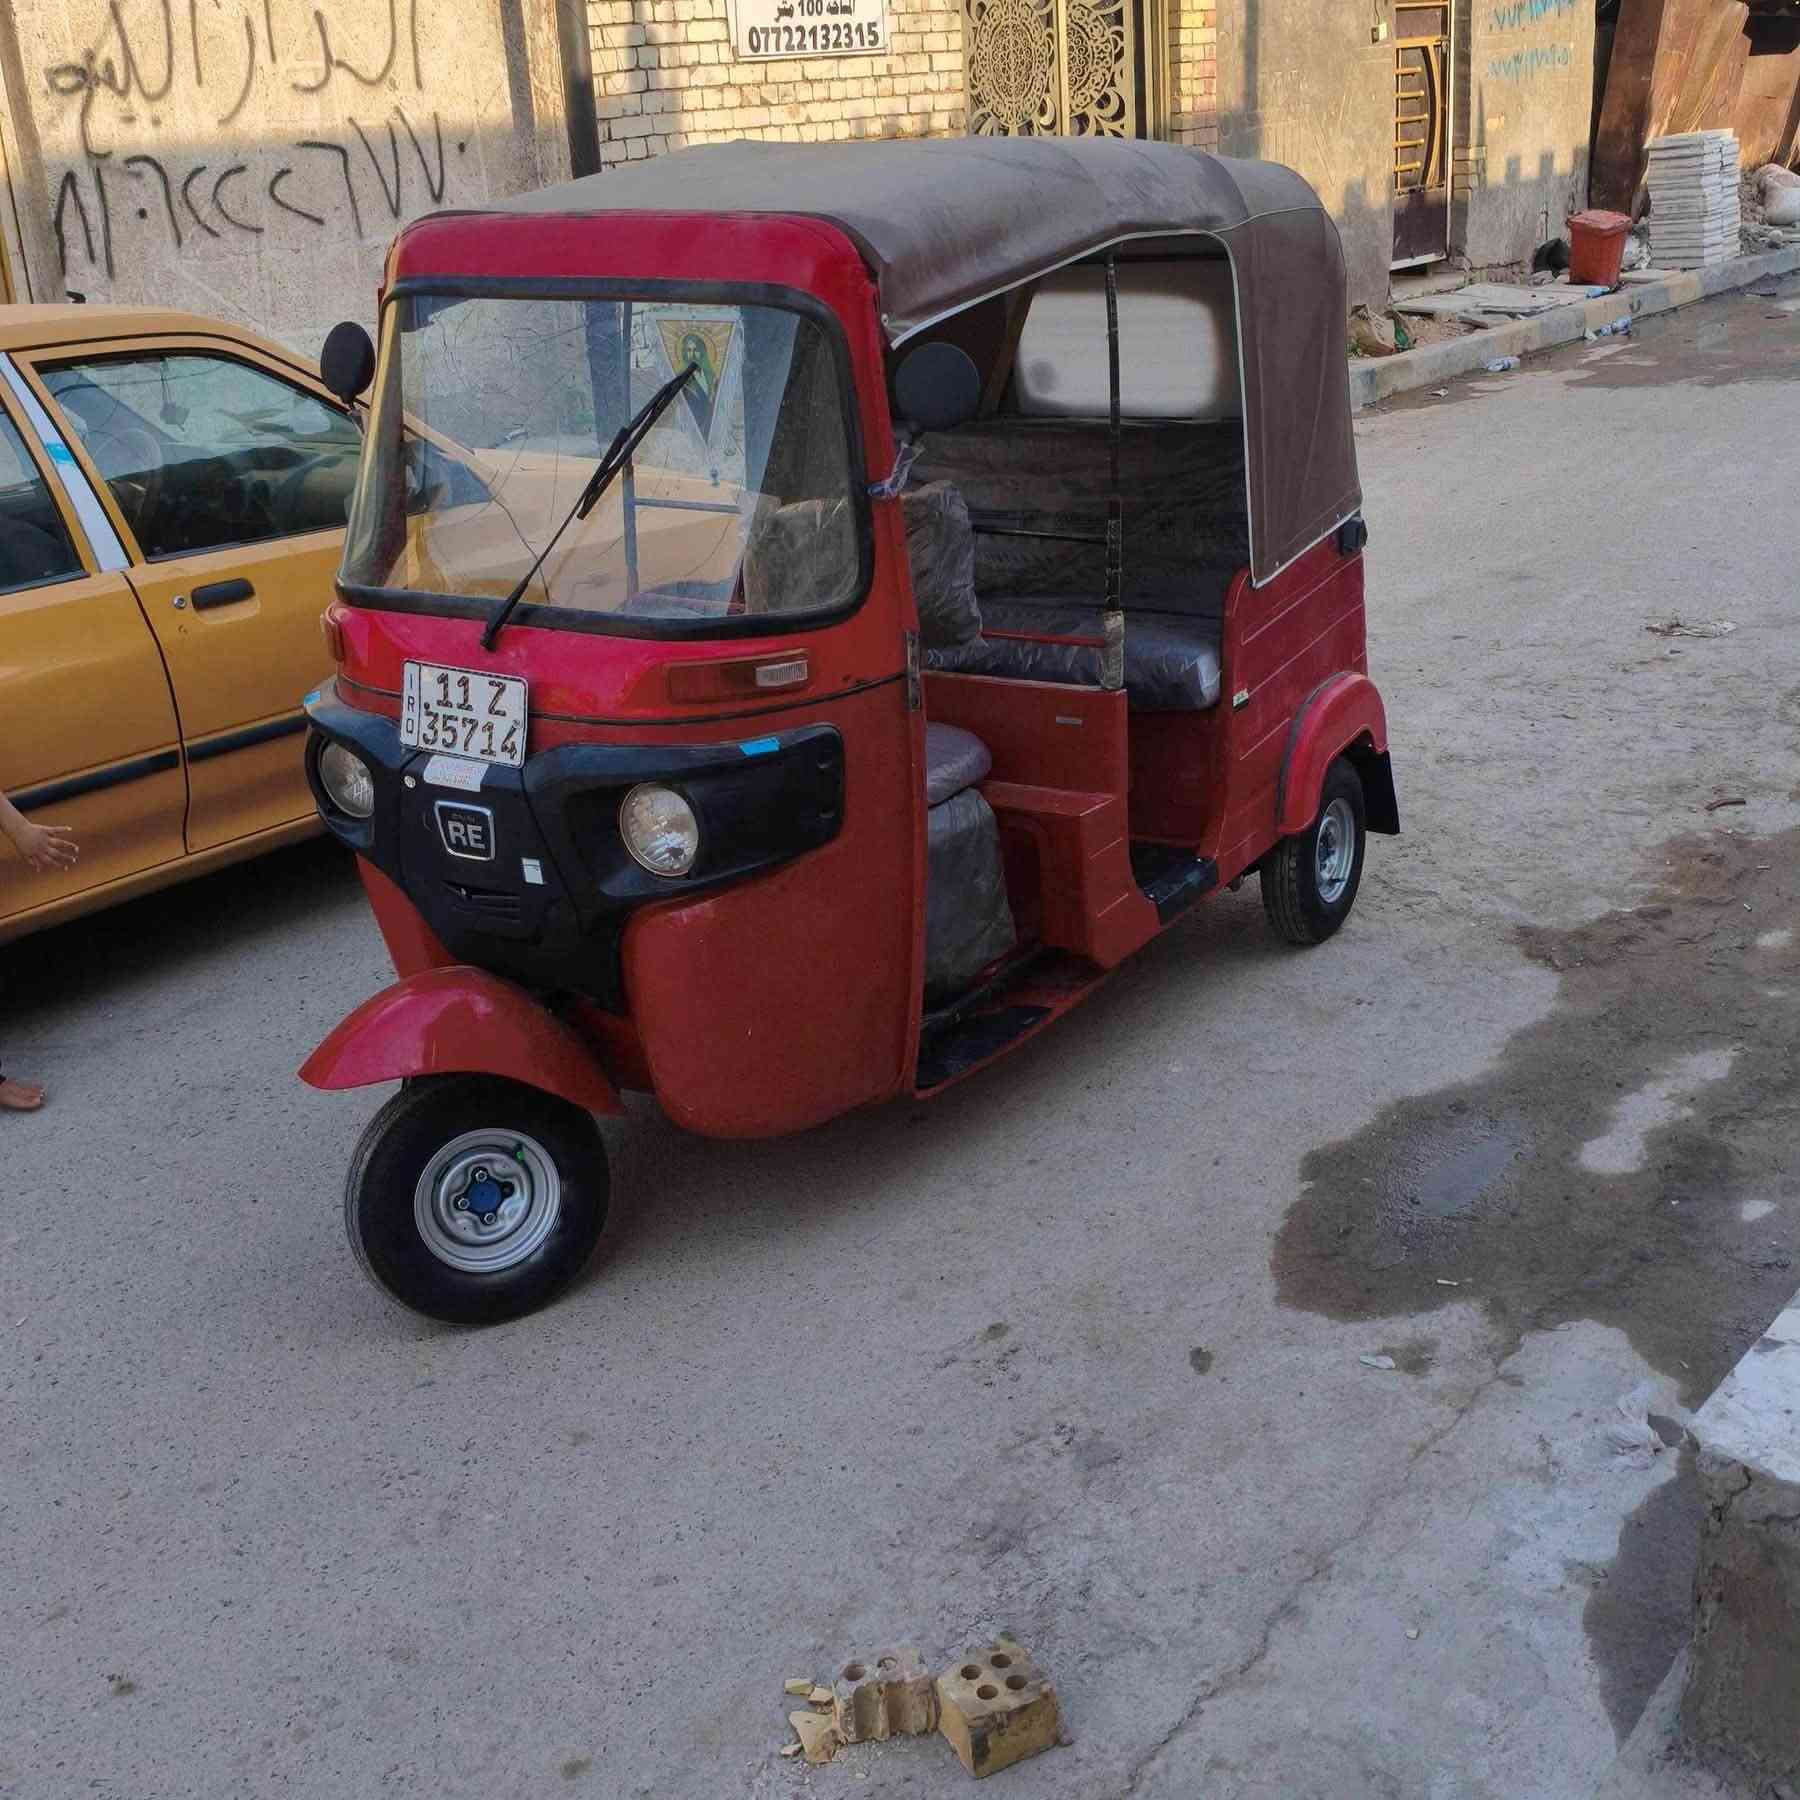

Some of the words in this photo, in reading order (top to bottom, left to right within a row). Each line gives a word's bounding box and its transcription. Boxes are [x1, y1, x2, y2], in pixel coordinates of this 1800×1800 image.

[798, 0, 824, 17] 100
[748, 21, 880, 53] 07722132315
[436, 672, 474, 712] 11
[487, 680, 507, 717] Z
[422, 710, 520, 760] 35714
[447, 820, 486, 849] RE
